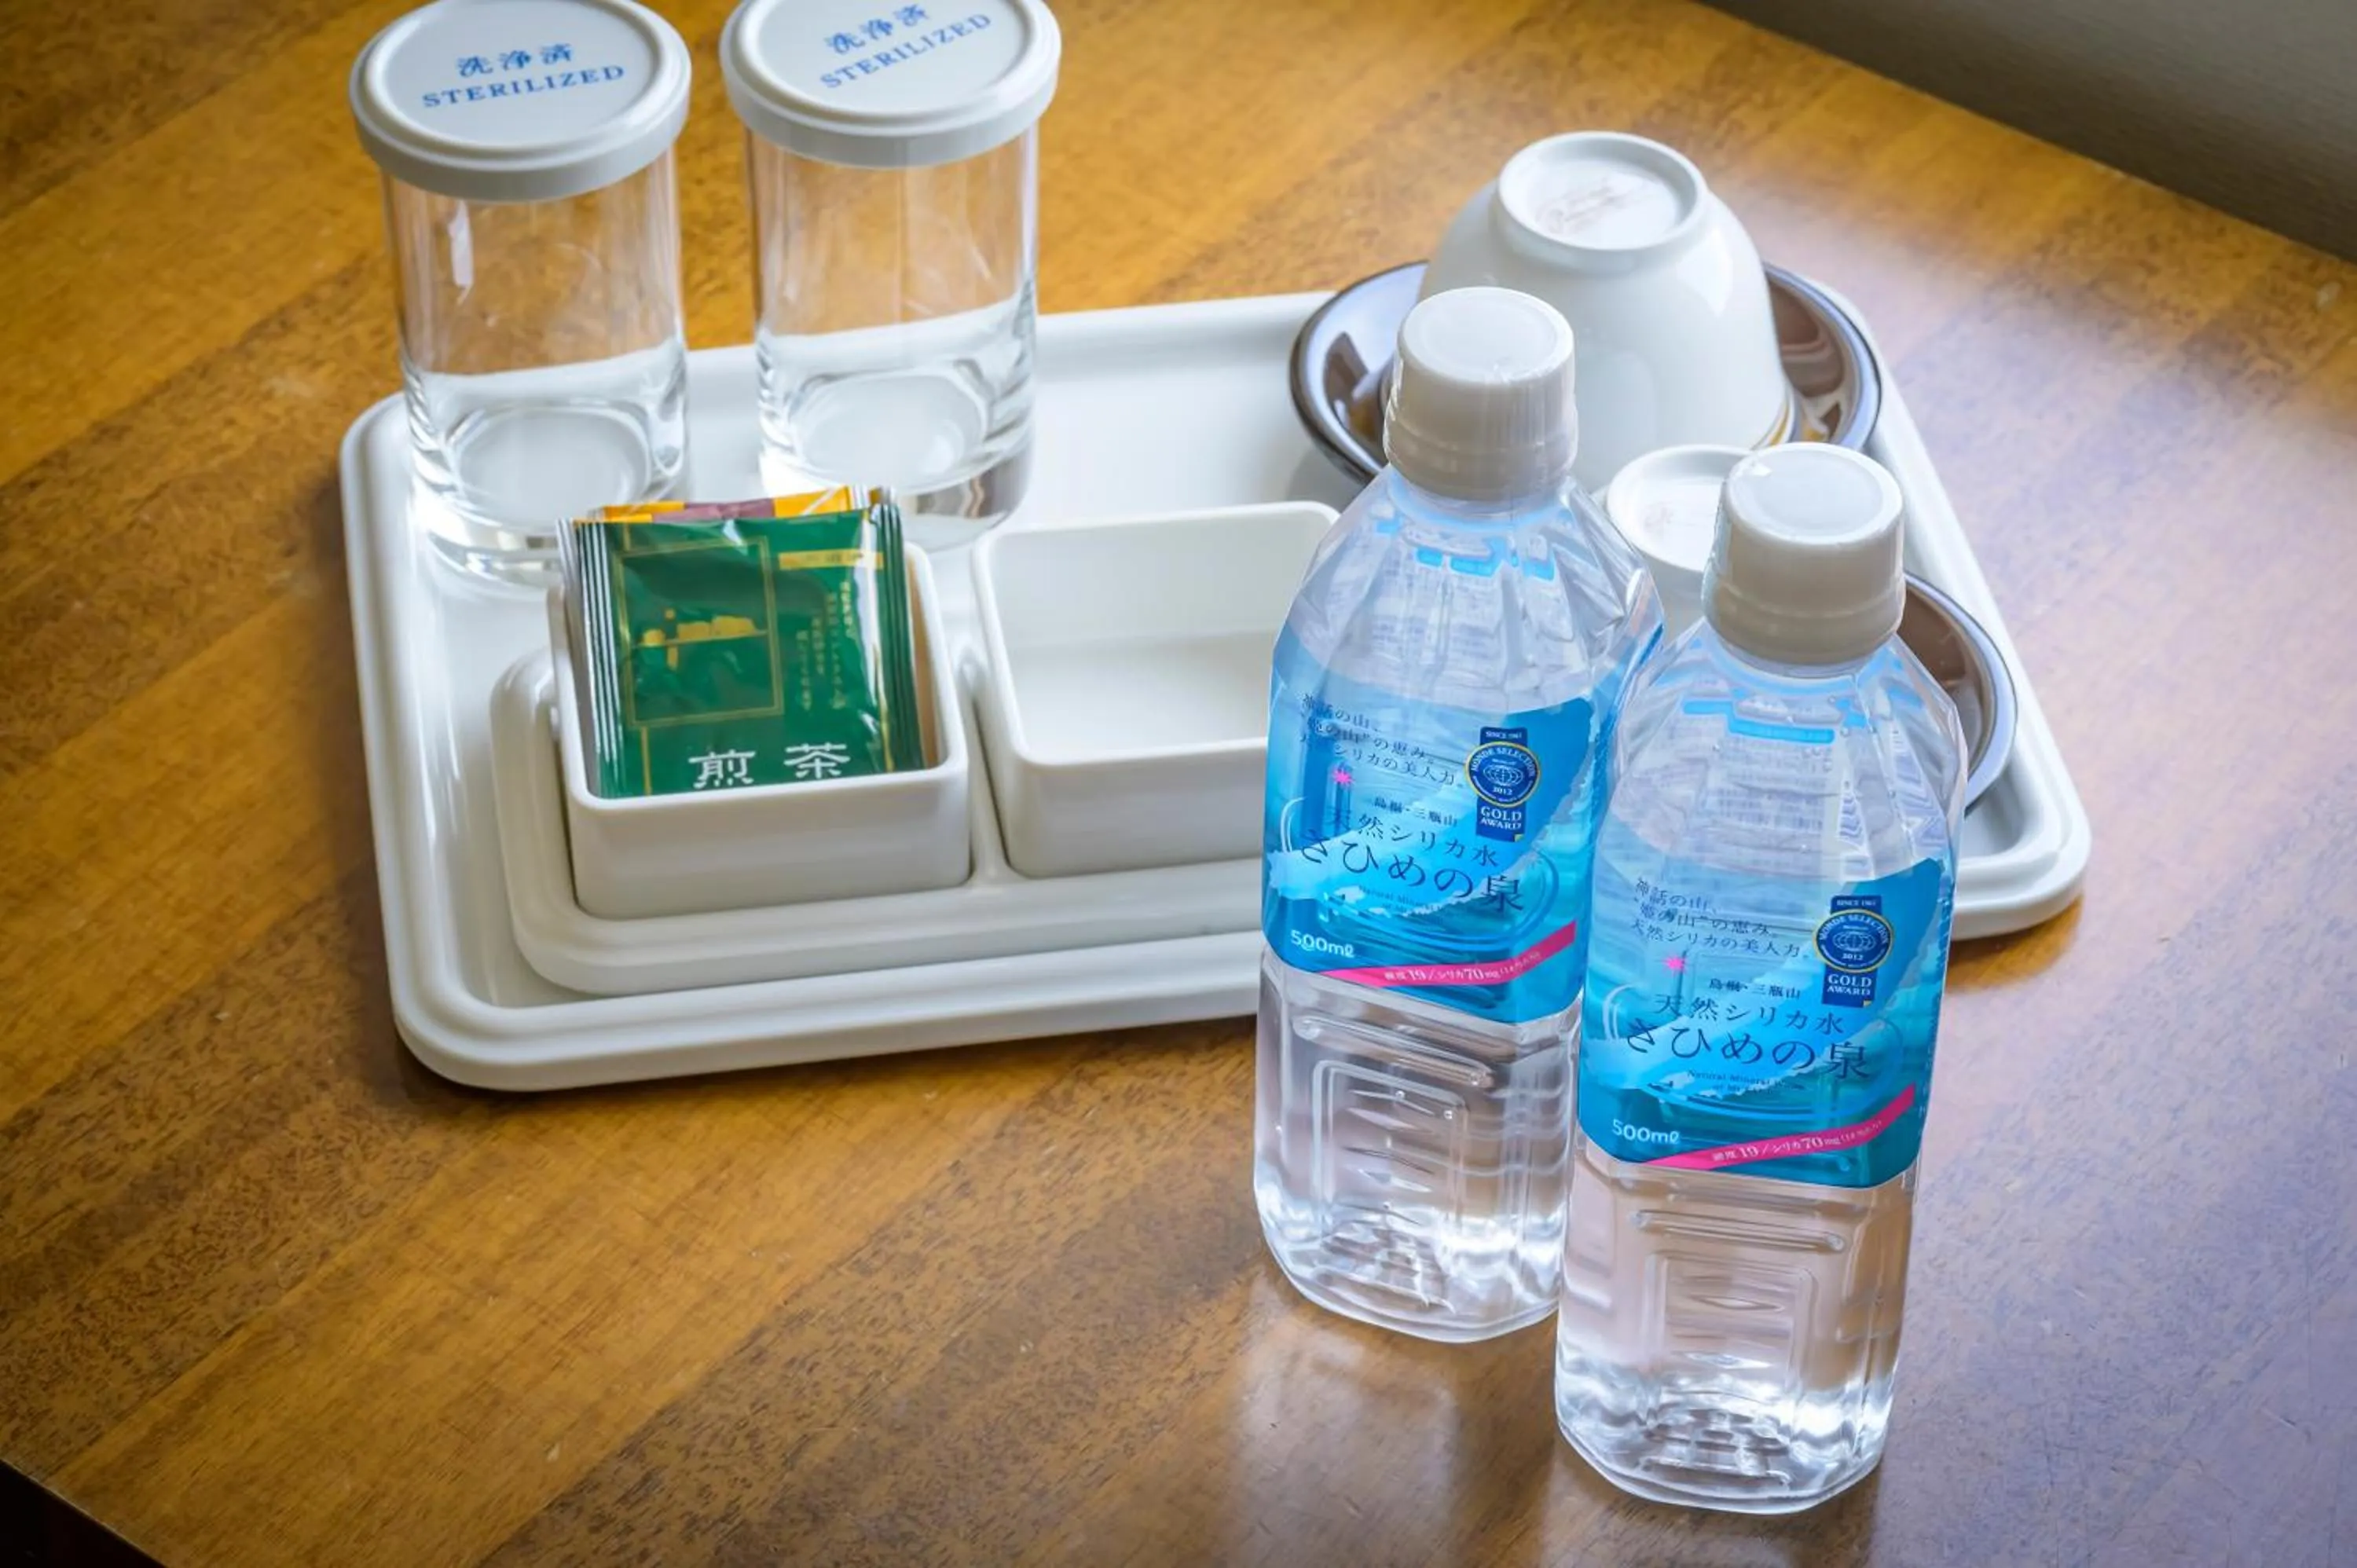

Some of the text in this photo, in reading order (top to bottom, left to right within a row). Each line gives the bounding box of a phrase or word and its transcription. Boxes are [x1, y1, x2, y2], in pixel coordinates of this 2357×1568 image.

[825, 4, 931, 55] 洗浄済
[455, 43, 574, 78] 洗浄済
[818, 13, 992, 90] STERILIZED
[422, 65, 626, 108] STERILIZED
[688, 742, 851, 790] 煎茶
[1480, 805, 1522, 822] GOLD
[1480, 816, 1522, 830] AWARD
[1300, 830, 1523, 912] さひめの泉
[1827, 973, 1872, 987] GOLD
[1827, 985, 1871, 996] AWARD
[1653, 994, 1845, 1035] 天然シリカ水
[1627, 1018, 1870, 1081] さひめの泉
